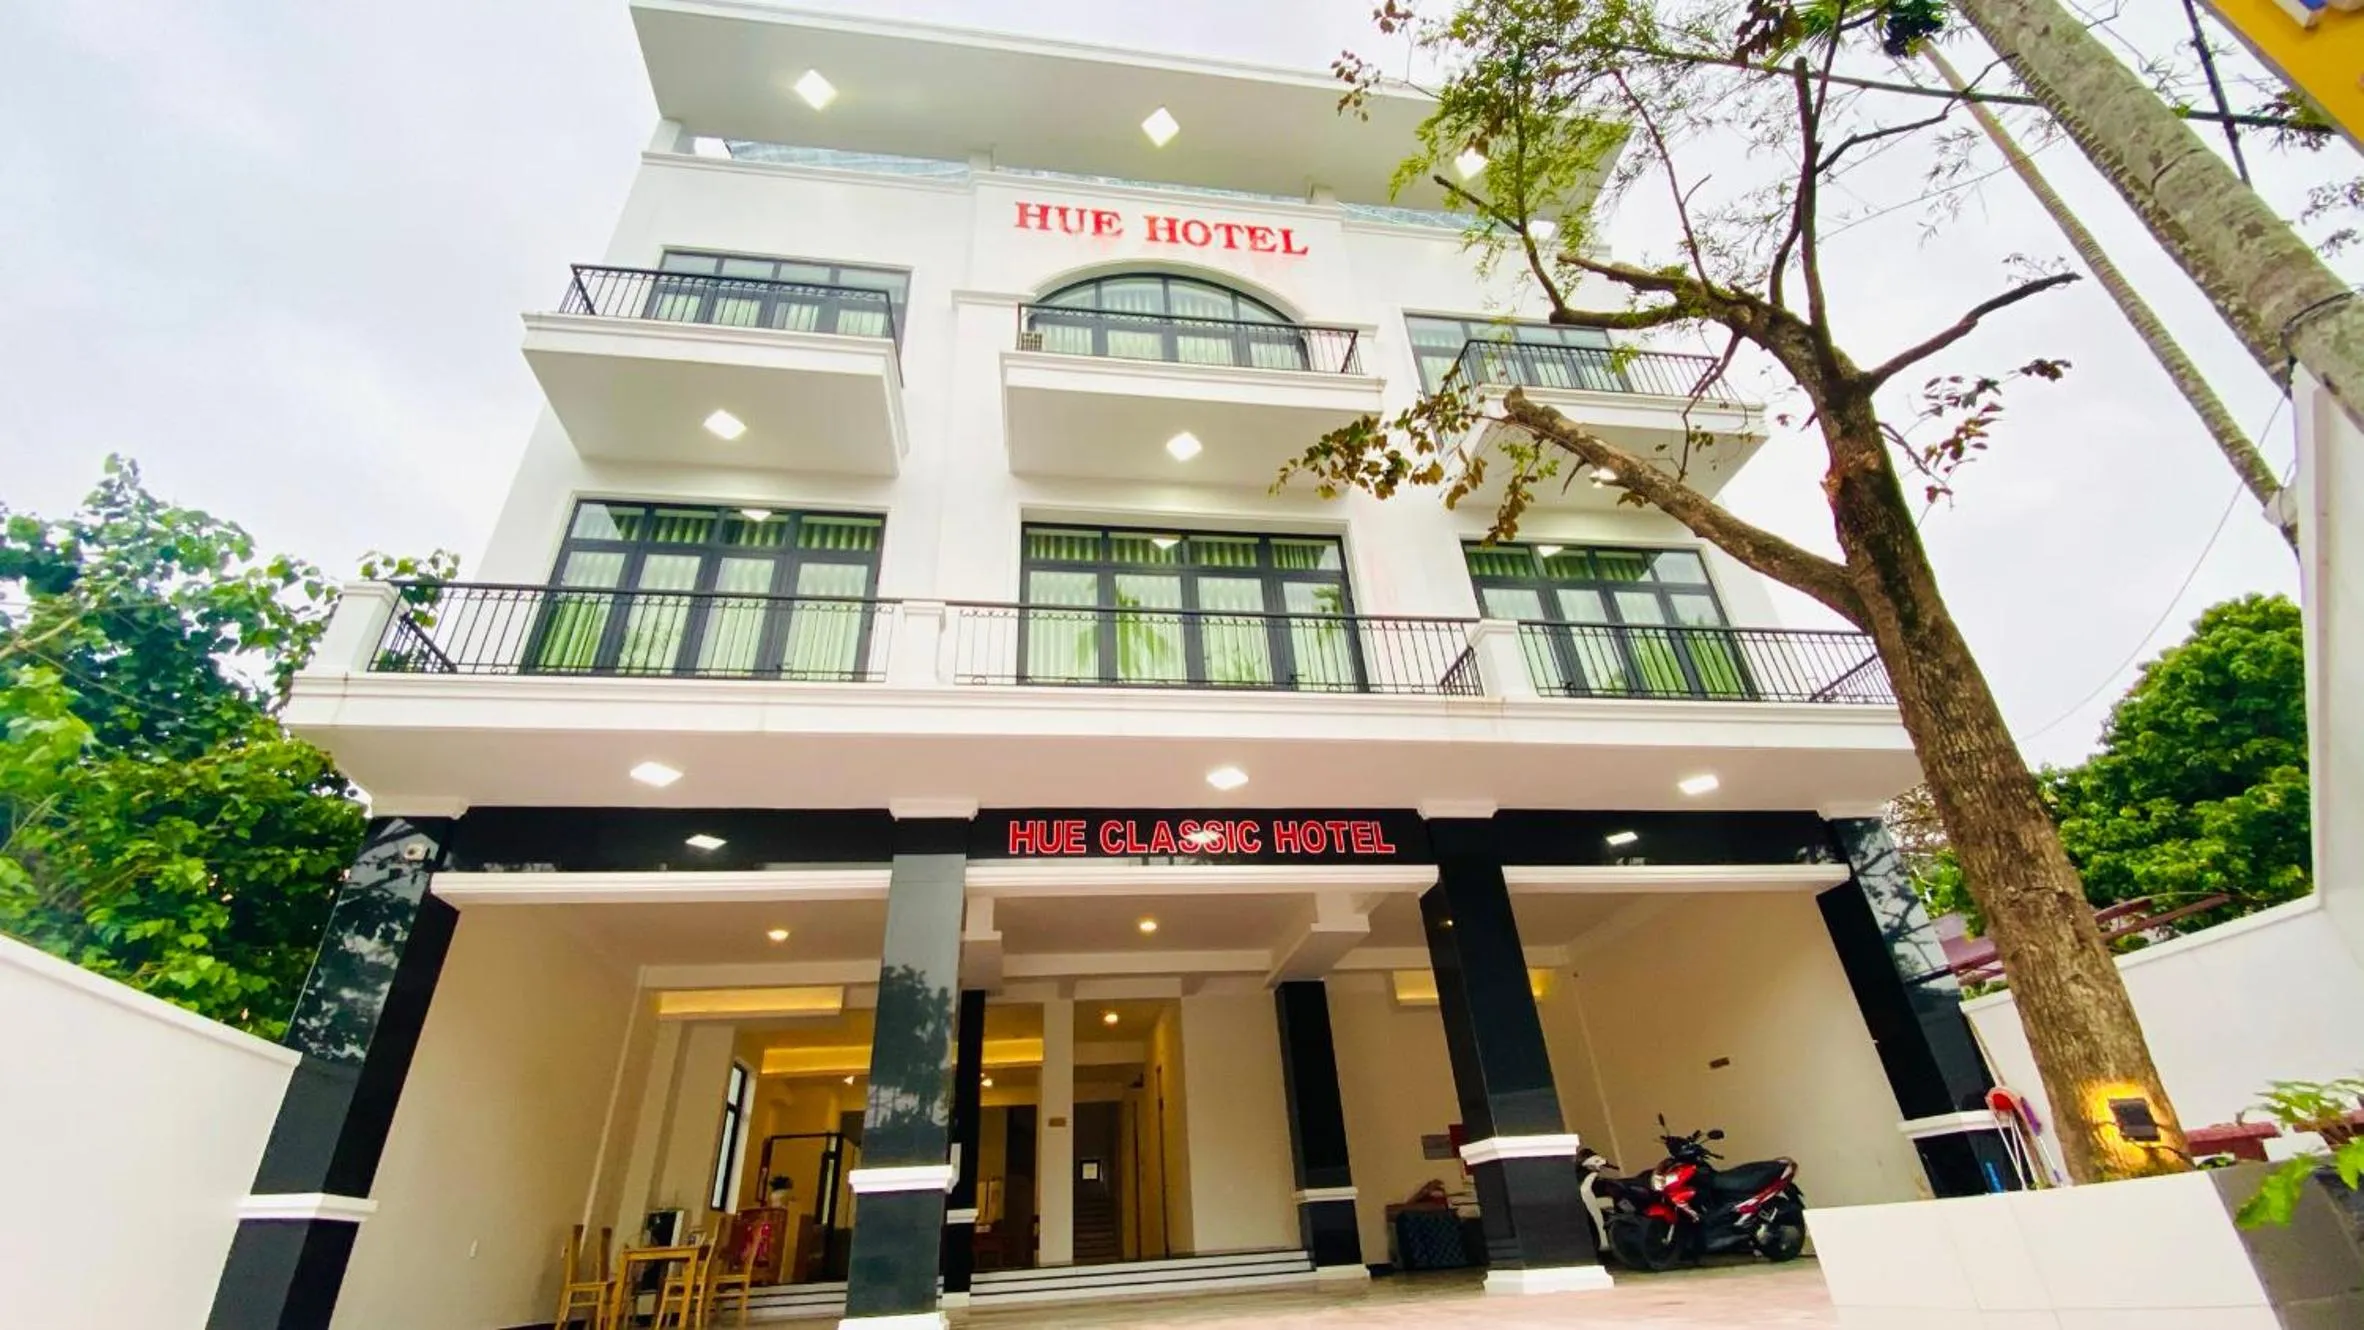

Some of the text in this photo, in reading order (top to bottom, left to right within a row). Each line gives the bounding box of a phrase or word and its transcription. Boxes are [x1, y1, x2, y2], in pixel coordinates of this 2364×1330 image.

[1015, 201, 1309, 256] HUE HOTEL
[1008, 820, 1396, 855] HUE CLASSIC HOTEL
